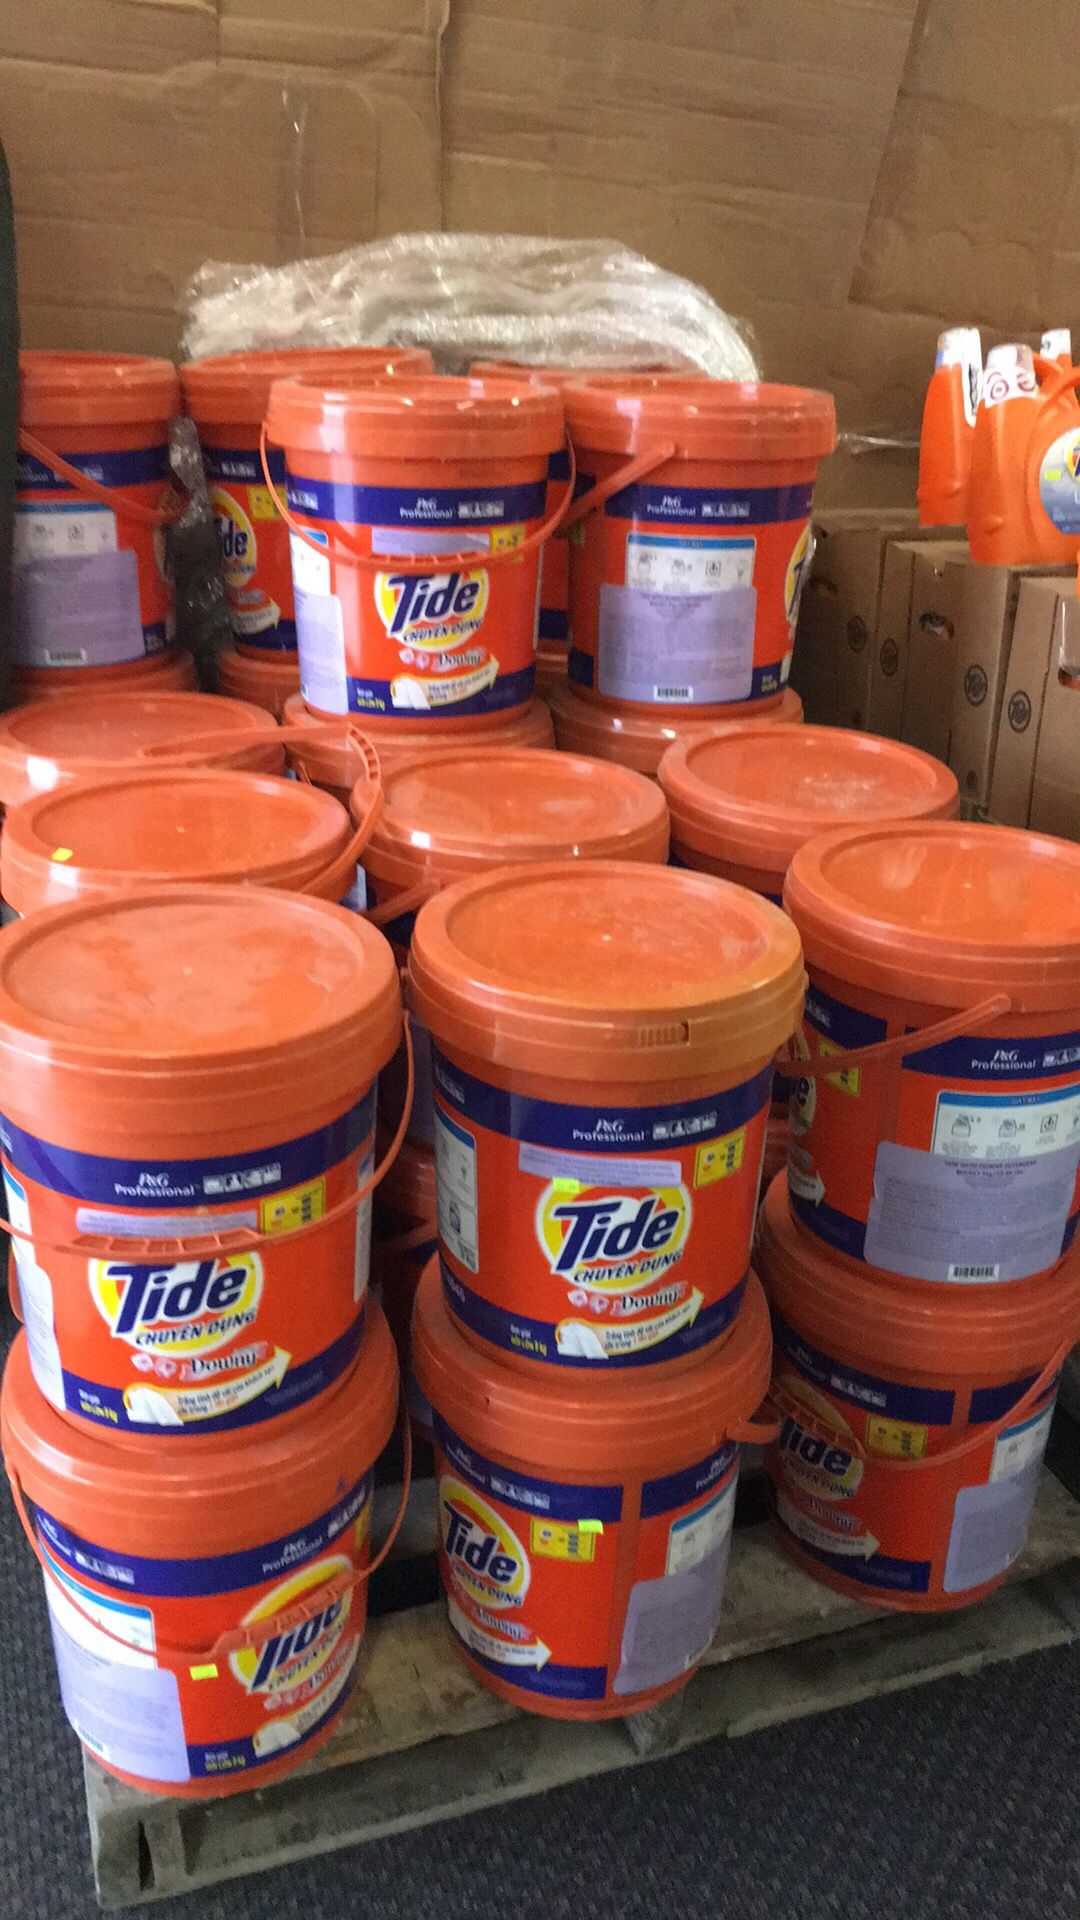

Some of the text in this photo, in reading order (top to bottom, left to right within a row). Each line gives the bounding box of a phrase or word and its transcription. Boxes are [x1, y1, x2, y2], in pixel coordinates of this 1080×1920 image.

[387, 573, 480, 635] Tide
[971, 1058, 1036, 1071] Professional
[572, 1129, 646, 1143] Professional
[114, 1183, 195, 1197] Professional
[553, 1197, 680, 1273] Tide
[106, 1258, 248, 1334] Tide
[621, 1291, 678, 1310] Downy
[191, 1352, 257, 1375] Downy
[444, 1500, 518, 1583] Tide
